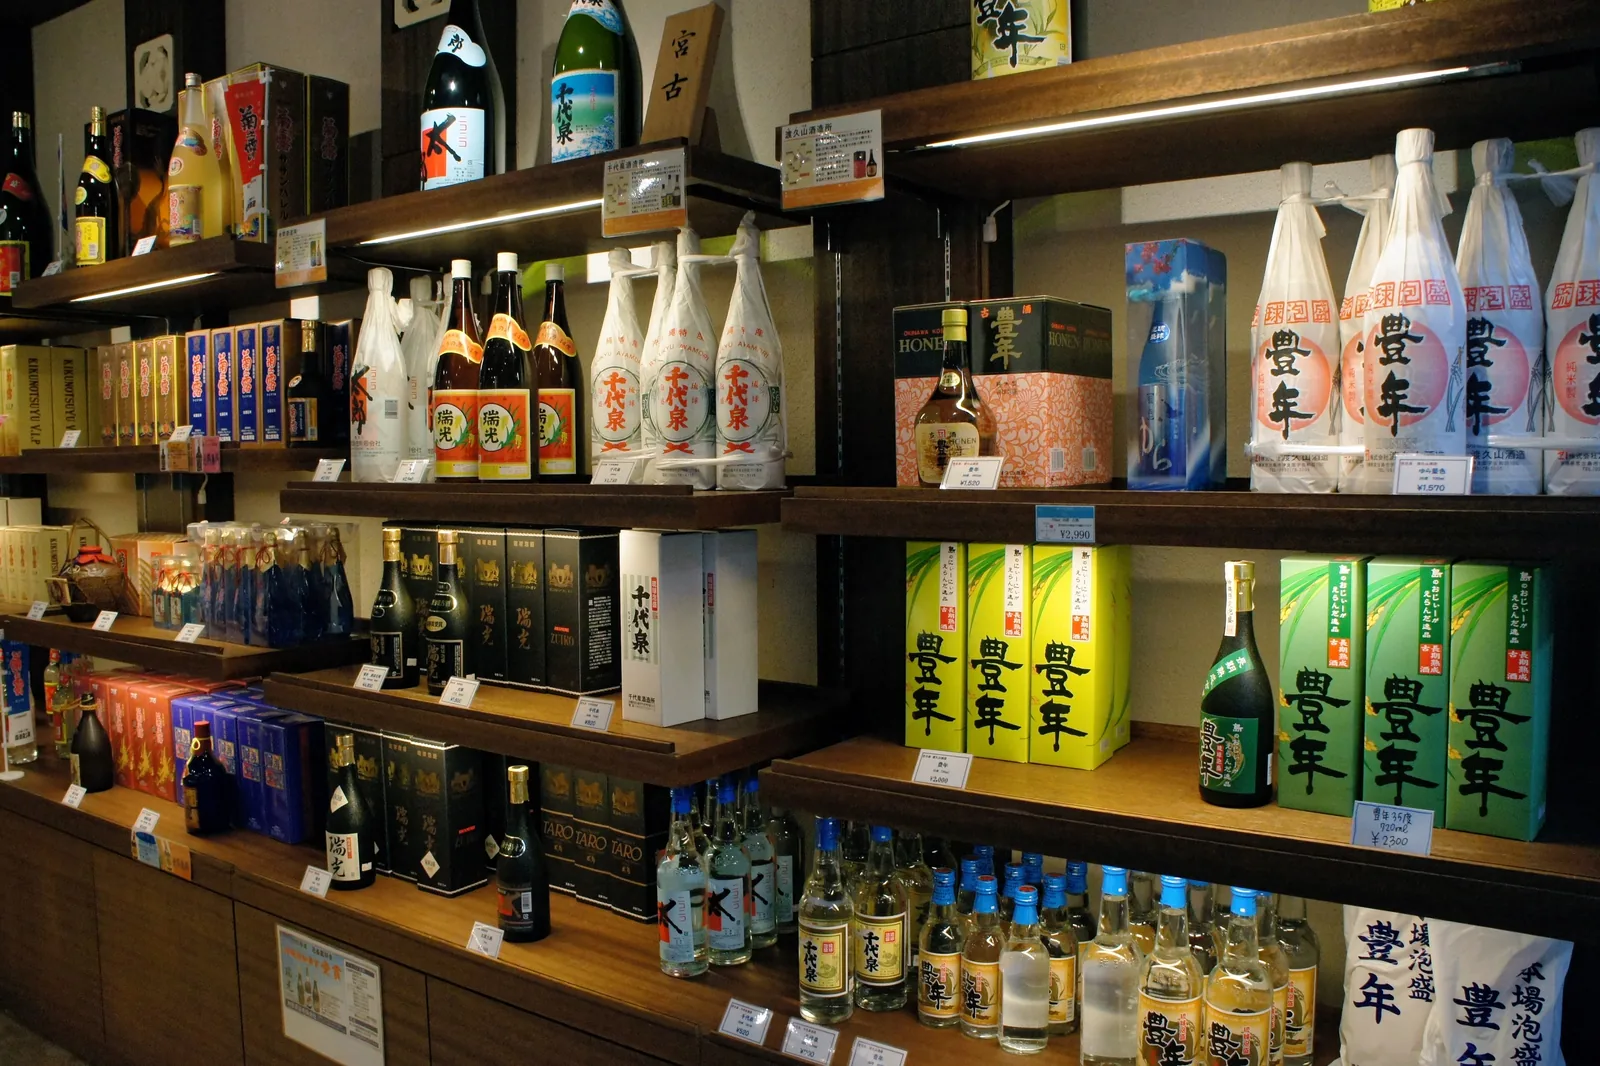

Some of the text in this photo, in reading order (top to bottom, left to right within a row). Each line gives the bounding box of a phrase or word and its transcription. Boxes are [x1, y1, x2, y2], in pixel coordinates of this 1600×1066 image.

[661, 29, 697, 102] 宮古
[555, 82, 575, 146] 千代泉
[784, 123, 833, 139] 渡久山酒造所
[899, 336, 944, 353] HONE
[27, 357, 42, 425] KIKUNOTSUYU
[63, 359, 77, 425] KIKUNOTSUYU
[664, 366, 689, 431] 千代泉
[724, 364, 750, 431] 千代泉
[1264, 329, 1316, 441] 豊年
[1373, 312, 1429, 438] 豊年
[436, 409, 454, 444] 瑞光
[602, 371, 627, 432] 千代泉
[482, 409, 501, 445] 瑞光
[959, 480, 981, 488] ¥1,520
[1416, 484, 1446, 493] ¥1,570
[1060, 530, 1091, 540] ¥2,990
[631, 585, 651, 655] 千代泉
[1331, 586, 1339, 632] えらんだ逸品
[1422, 590, 1431, 638] えらんだ逸品
[1509, 594, 1519, 643] えらんだ逸品
[909, 631, 957, 737] 豊年
[971, 636, 1023, 746] 豊年
[1035, 640, 1091, 753] 豊年
[1286, 666, 1351, 795] 豊年
[1371, 673, 1443, 806] 豊年
[1456, 679, 1532, 818] 豊年
[929, 775, 949, 784] ¥2,000
[543, 820, 574, 840] TARO
[575, 830, 608, 851] TARO
[611, 839, 643, 862] TARO
[1380, 822, 1409, 834] 720ml
[328, 836, 347, 878] 瑞光
[803, 940, 819, 983] 千代泉
[862, 931, 879, 972] 千代泉
[1353, 920, 1405, 1025] 豊年
[920, 959, 953, 1011] 豊年
[736, 1027, 750, 1037] ¥520
[1511, 961, 1547, 1066] 本場泡盛
